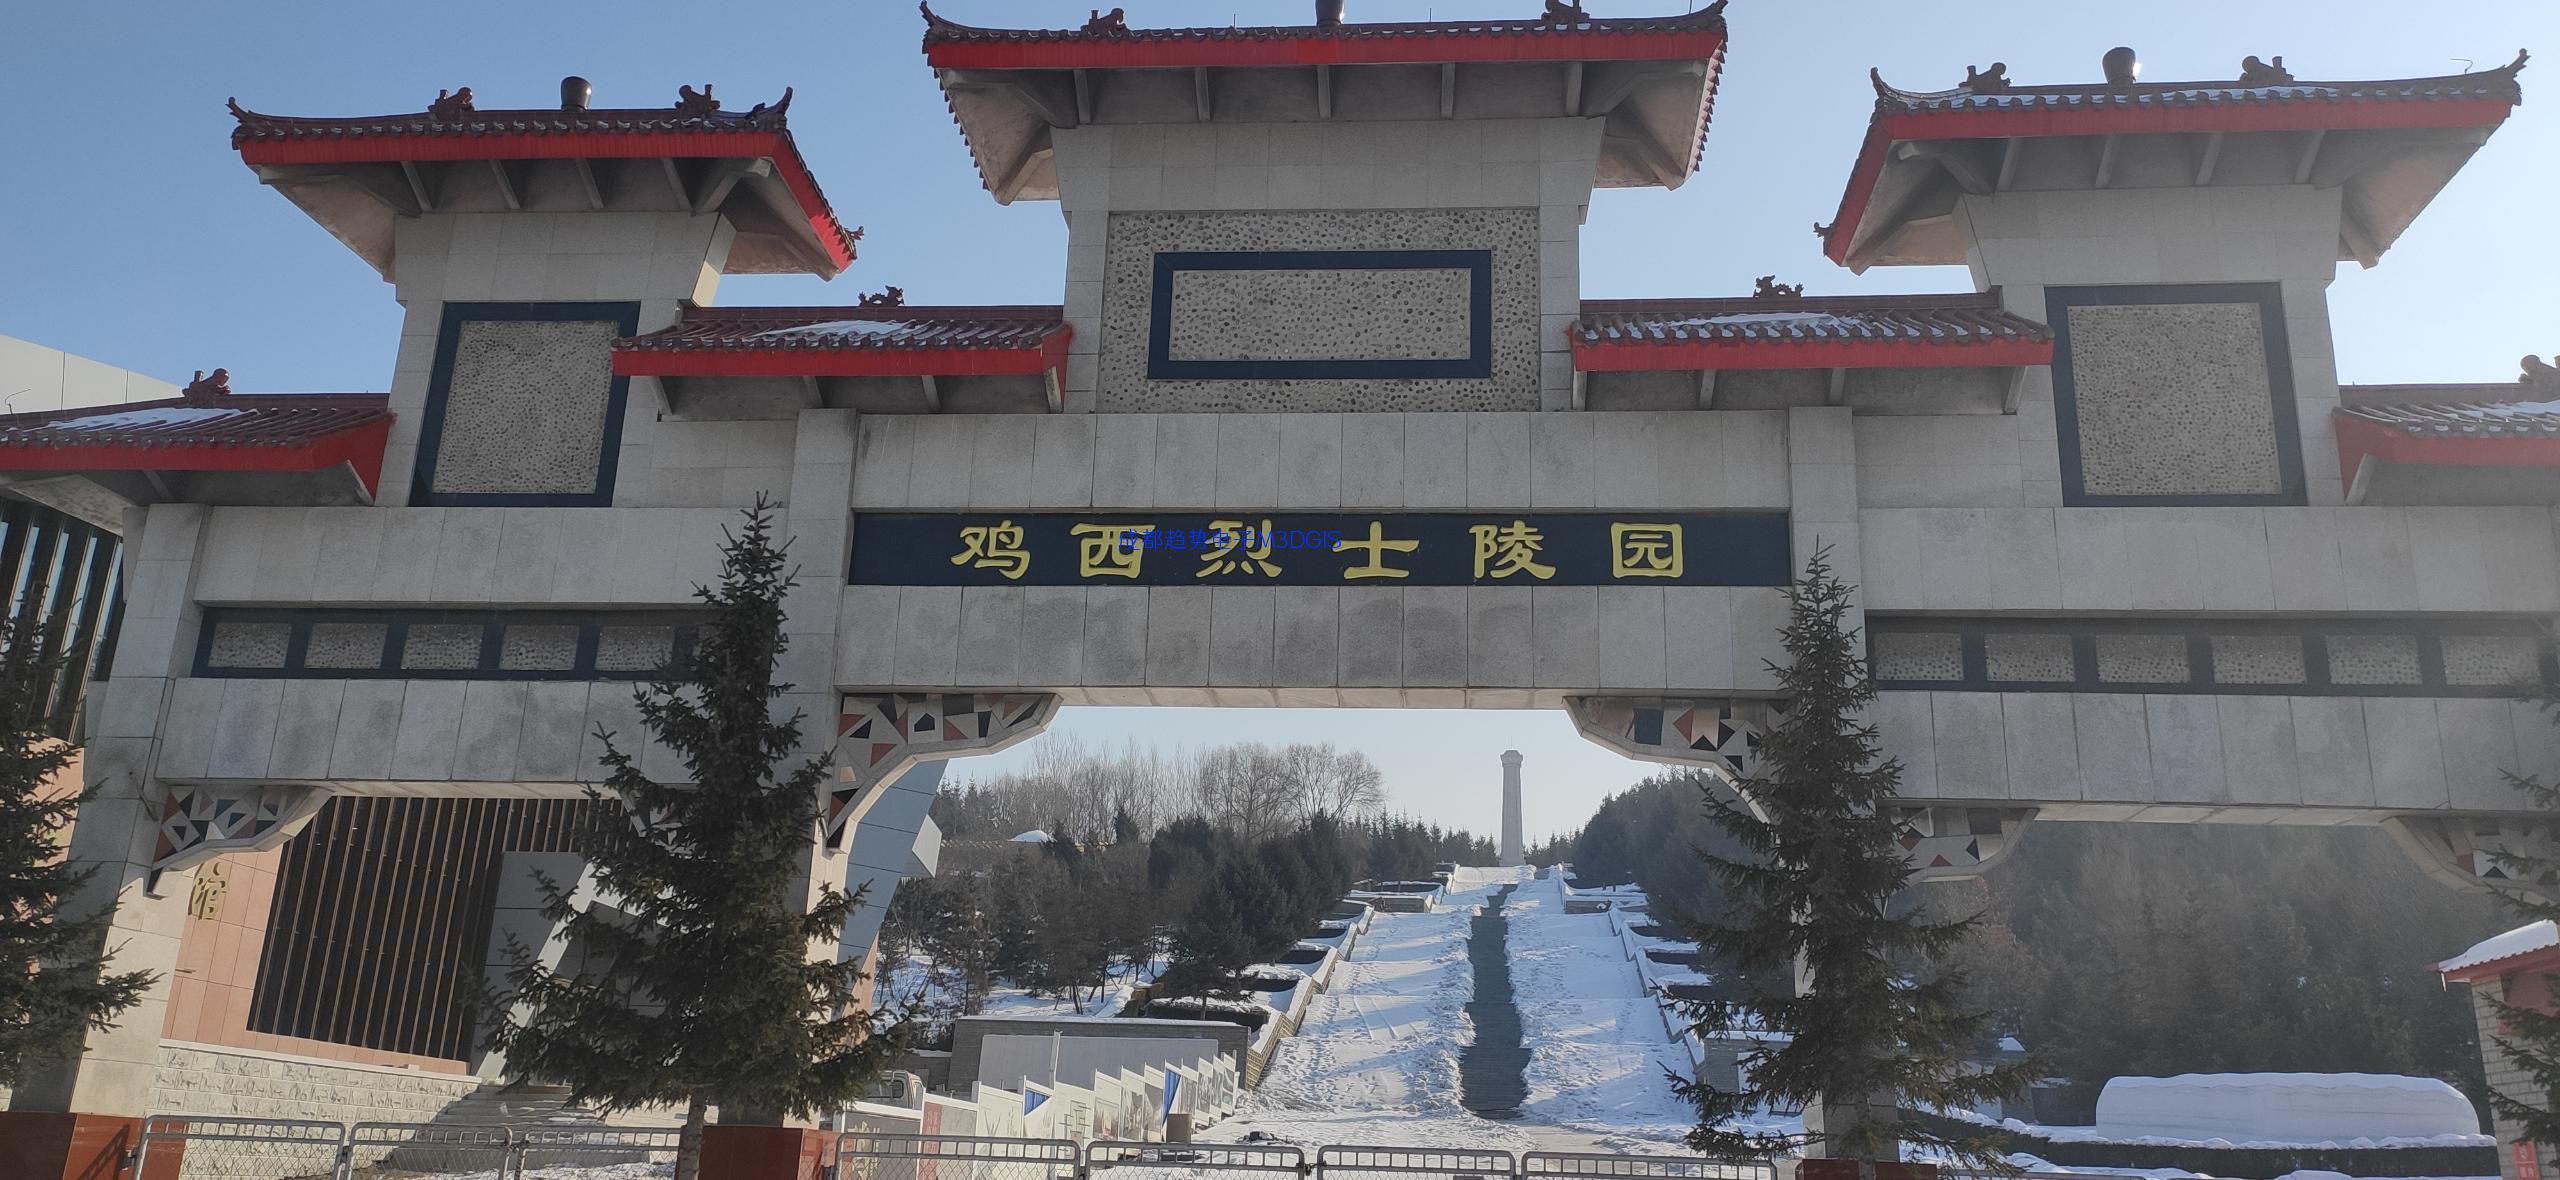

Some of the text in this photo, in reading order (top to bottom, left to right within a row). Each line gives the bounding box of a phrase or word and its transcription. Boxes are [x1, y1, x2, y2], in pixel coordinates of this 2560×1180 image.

[951, 519, 1683, 579] 鸡西烈士陵园
